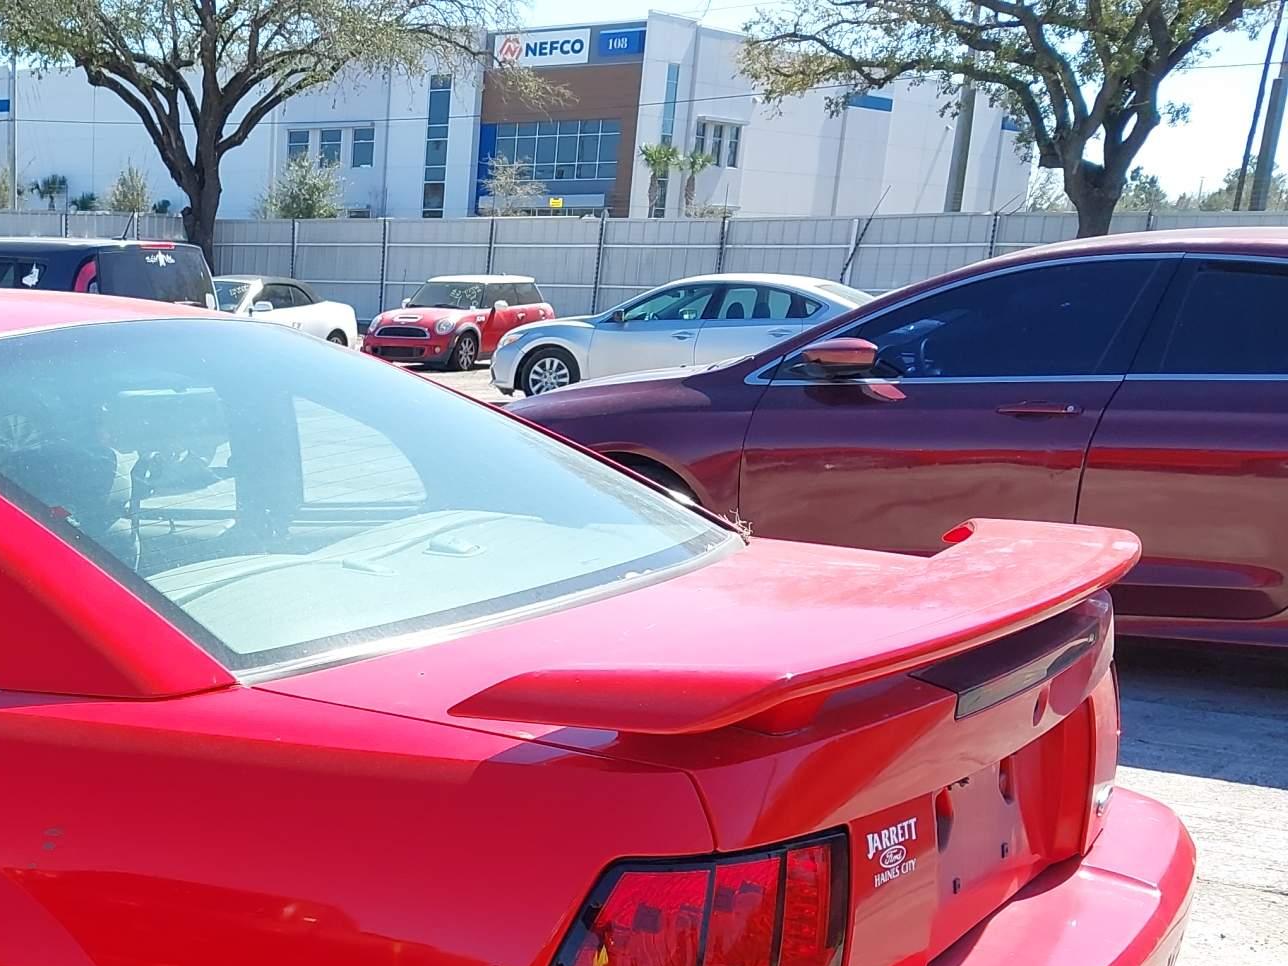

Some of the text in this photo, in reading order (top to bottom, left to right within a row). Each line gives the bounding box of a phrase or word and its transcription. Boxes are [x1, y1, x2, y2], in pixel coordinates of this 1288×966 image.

[525, 39, 584, 57] NEFCO
[608, 37, 628, 50] 108
[866, 817, 917, 860] JARRETT
[883, 848, 903, 866] Ford
[874, 858, 917, 888] HAINES CITY
